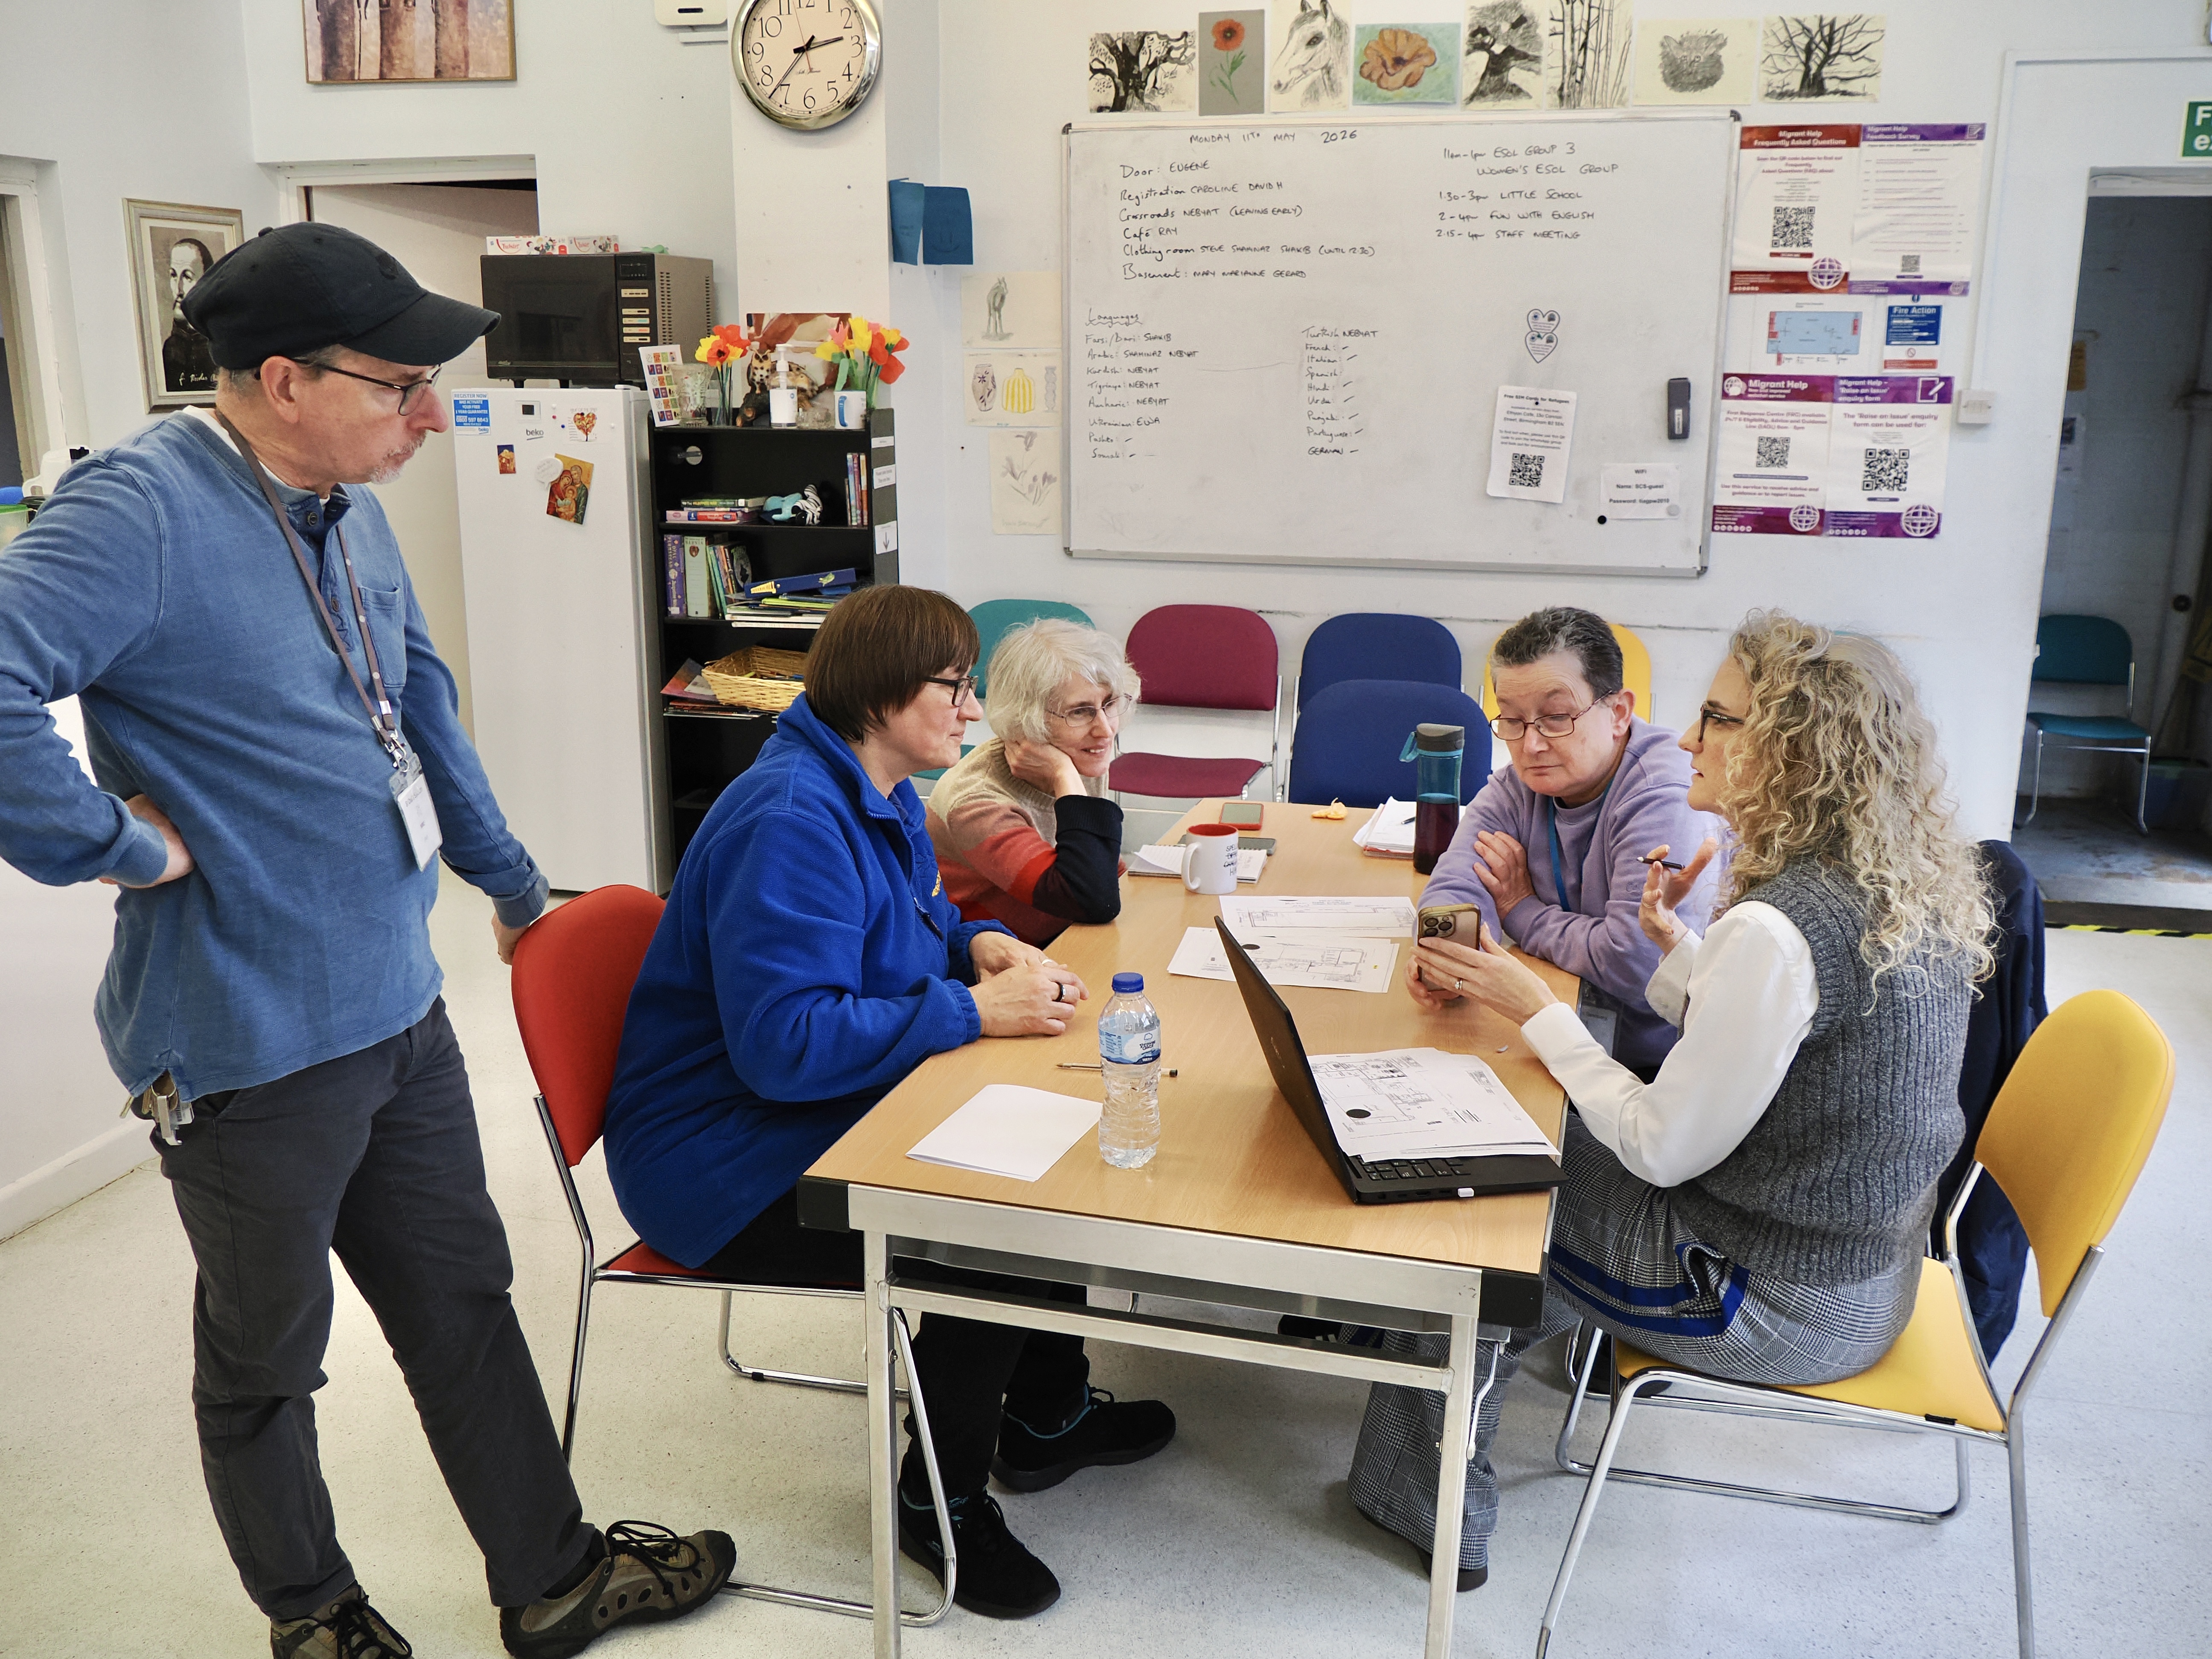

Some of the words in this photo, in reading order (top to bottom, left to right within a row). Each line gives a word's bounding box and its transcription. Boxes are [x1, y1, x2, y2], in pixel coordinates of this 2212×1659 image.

[840, 7, 853, 29] 2
[758, 16, 782, 38] 10
[752, 42, 764, 63] 9
[851, 35, 863, 58] 3
[761, 65, 773, 86] 8
[842, 60, 853, 82] 4
[780, 83, 790, 104] 7
[803, 87, 815, 109] 6
[827, 80, 838, 103] 5
[2195, 105, 2212, 126] F
[1190, 133, 1231, 143] MONDAY
[1274, 132, 1295, 142] MAY
[1321, 130, 1357, 143] 2026
[1778, 130, 1806, 139] Migrant
[2193, 134, 2212, 151] e
[1494, 146, 1519, 158] ESOL
[1524, 144, 1557, 156] GROUP
[1566, 142, 1576, 154] 3
[1169, 160, 1211, 173] EUGENE
[1476, 165, 1529, 176] WOMEN'S
[1536, 163, 1566, 174] ESOL
[1580, 163, 1619, 174] GROUP
[1120, 185, 1186, 206] Registration
[1190, 183, 1239, 194] CAROLINE
[1248, 182, 1274, 191] DAVID
[1276, 181, 1283, 190] H
[1500, 190, 1537, 199] LITTLE
[1545, 188, 1583, 200] SCHOOL
[1119, 208, 1176, 222] Crossroads
[1183, 208, 1220, 217] NEBYAT
[1229, 205, 1269, 217] (LEAVING
[1271, 204, 1303, 218] EARLY)
[1490, 210, 1511, 220] FUN
[1517, 211, 1543, 219] WITH
[1551, 210, 1595, 220] ENGLISH
[1158, 227, 1178, 236] RAY
[1495, 229, 1526, 239] STAFF
[1533, 230, 1581, 239] MEETING
[1123, 244, 1164, 262] Clothing
[1200, 244, 1225, 253] STEVE
[1318, 244, 1346, 255] (UNTIL
[1221, 269, 1266, 278] MARIANNE
[1272, 269, 1307, 278] GERARD
[1911, 306, 1936, 314] Action
[1088, 307, 1140, 328] Languages
[1144, 332, 1172, 342] SHAKIB
[1343, 329, 1379, 338] NEBYAT
[1127, 366, 1160, 374] NEBYAT
[1129, 380, 1161, 389] NEBYAT
[1748, 379, 1786, 389] Migrant
[1786, 380, 1809, 390] Help
[1136, 396, 1170, 406] NEBYAT
[1136, 416, 1160, 426] EWA
[1308, 446, 1343, 456] GERMAN
